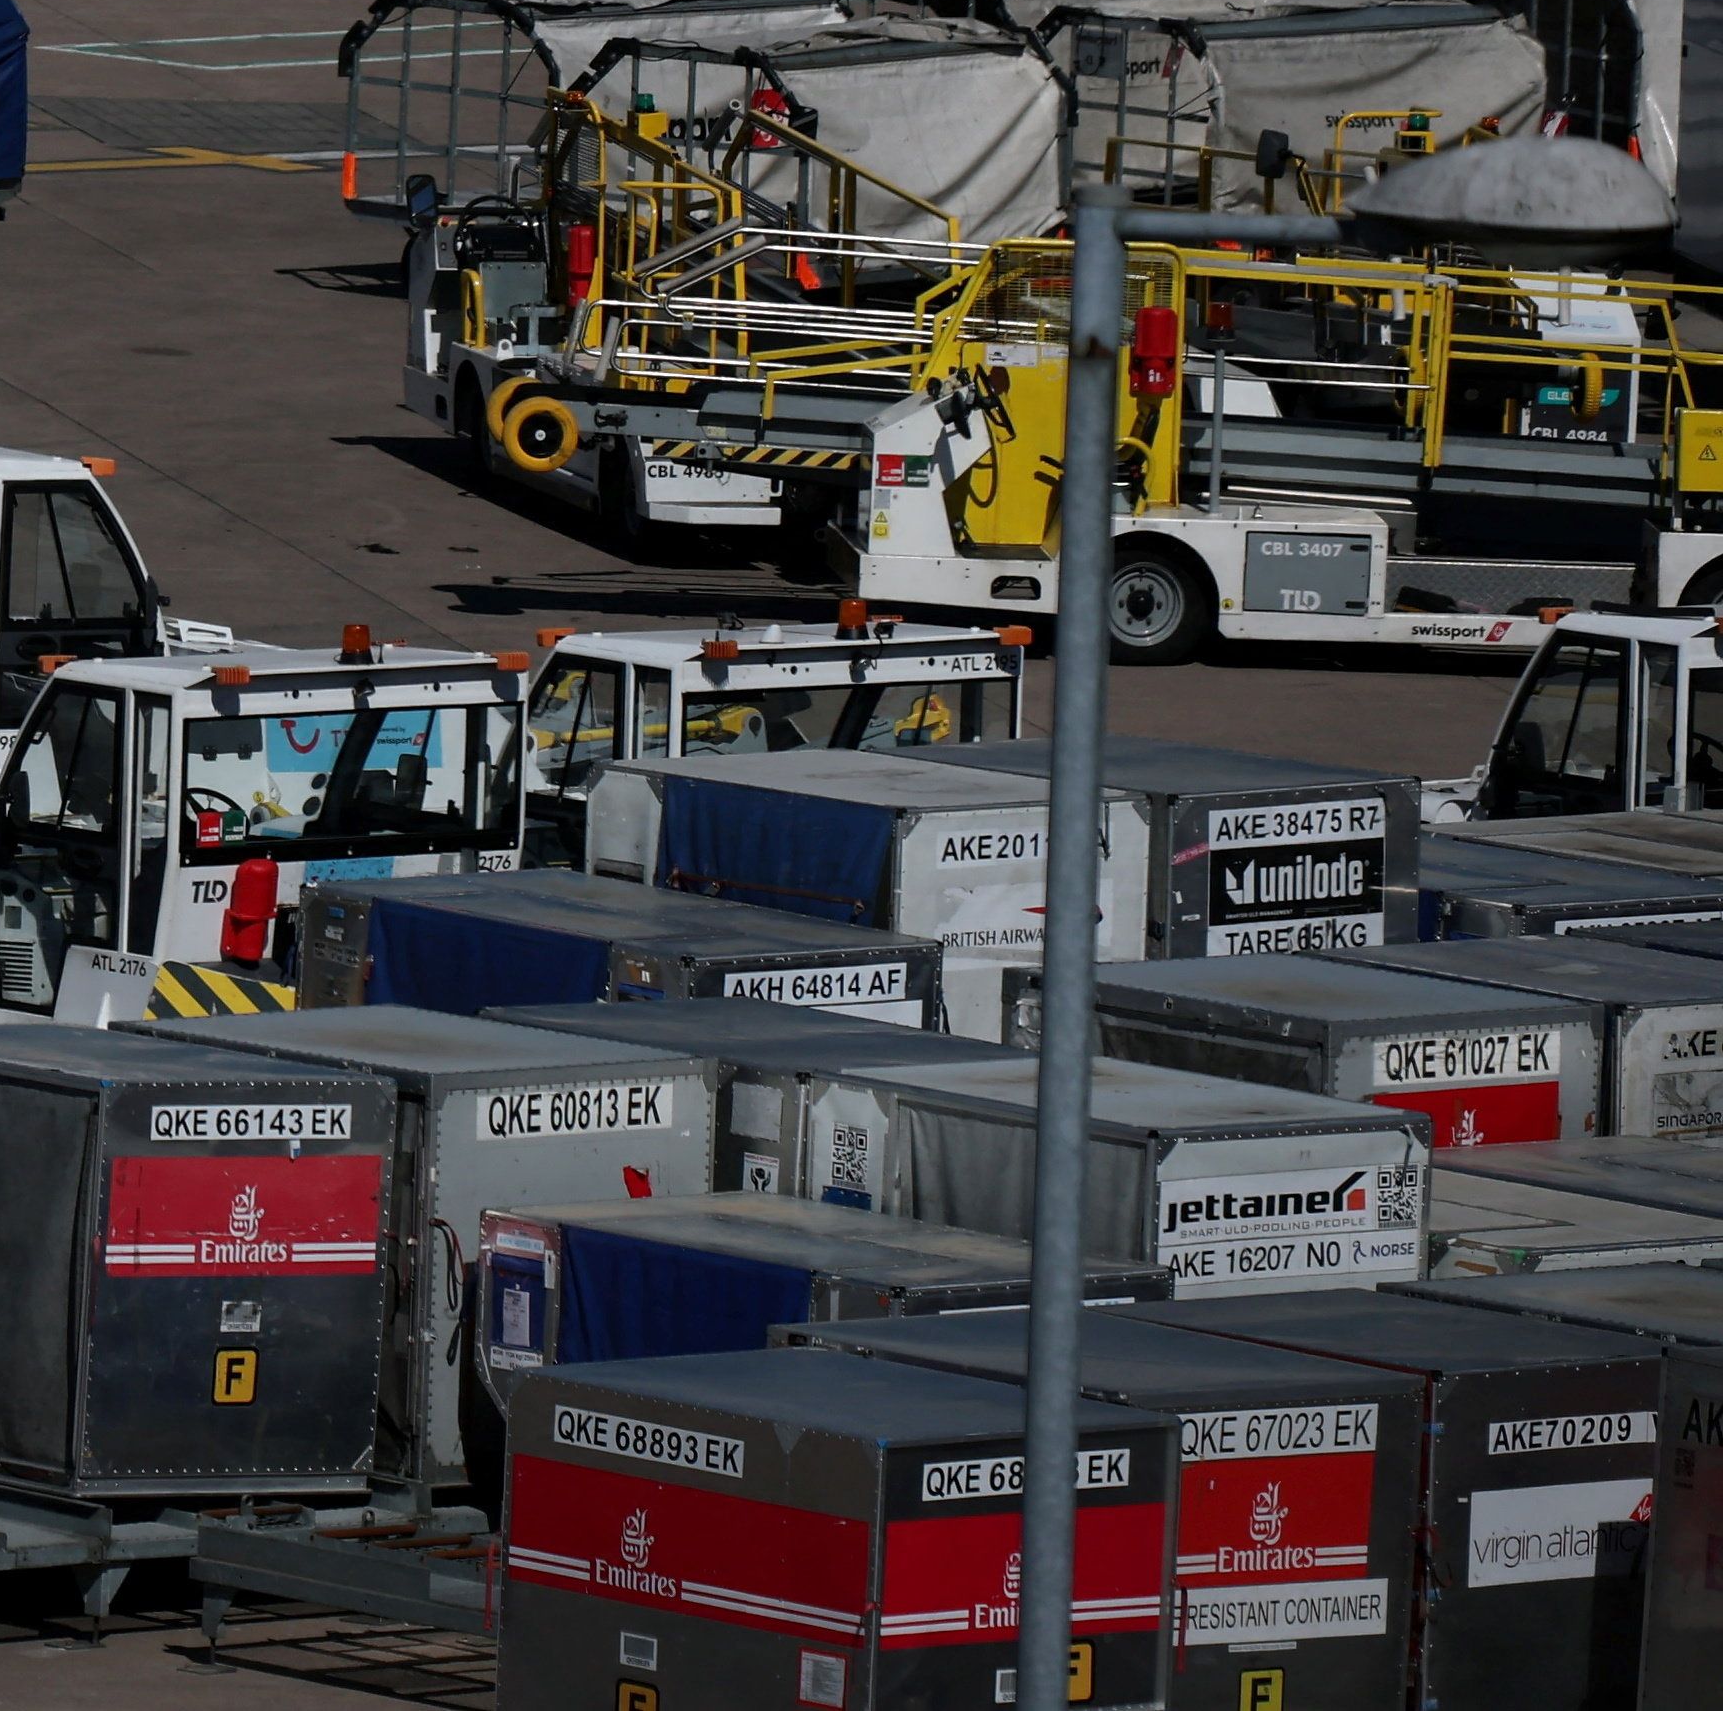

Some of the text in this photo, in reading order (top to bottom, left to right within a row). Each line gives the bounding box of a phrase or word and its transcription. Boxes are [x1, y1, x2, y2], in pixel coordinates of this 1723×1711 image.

[647, 465, 677, 478] CBL
[1261, 541, 1343, 556] CBL 3407
[1279, 589, 1321, 611] TLD
[1411, 624, 1485, 640] swissport
[951, 656, 981, 672] ATL
[1215, 805, 1381, 842] AKE 38475 R7
[191, 880, 228, 904] TLD
[1259, 853, 1363, 903] unilode
[942, 930, 996, 948] BRITISH
[1225, 922, 1368, 957] TARE 65 KG
[92, 954, 147, 977] ATL 2176
[731, 968, 902, 1002] AKH 64814 AF
[1385, 1032, 1550, 1083] QKE 61027 EK
[155, 1108, 347, 1138] QKE 66143 EK
[488, 1085, 662, 1138] QKE 60813 EK
[1162, 1170, 1368, 1234] jettainer
[200, 1239, 287, 1265] Emirates
[1168, 1244, 1295, 1279] AKE 16207
[1371, 1241, 1416, 1258] NORSE
[224, 1357, 245, 1396] F
[557, 1409, 740, 1474] QKE 68893 EK
[1181, 1409, 1372, 1457] QKE 67023 EK
[926, 1463, 982, 1498] QKE
[1087, 1452, 1125, 1485] EK
[1218, 1544, 1315, 1573] Emirates
[1473, 1521, 1637, 1568] virgin atlantic
[595, 1557, 677, 1599] Emirates
[1188, 1600, 1280, 1631] RESISTANT
[1284, 1594, 1381, 1626] CONTAINER
